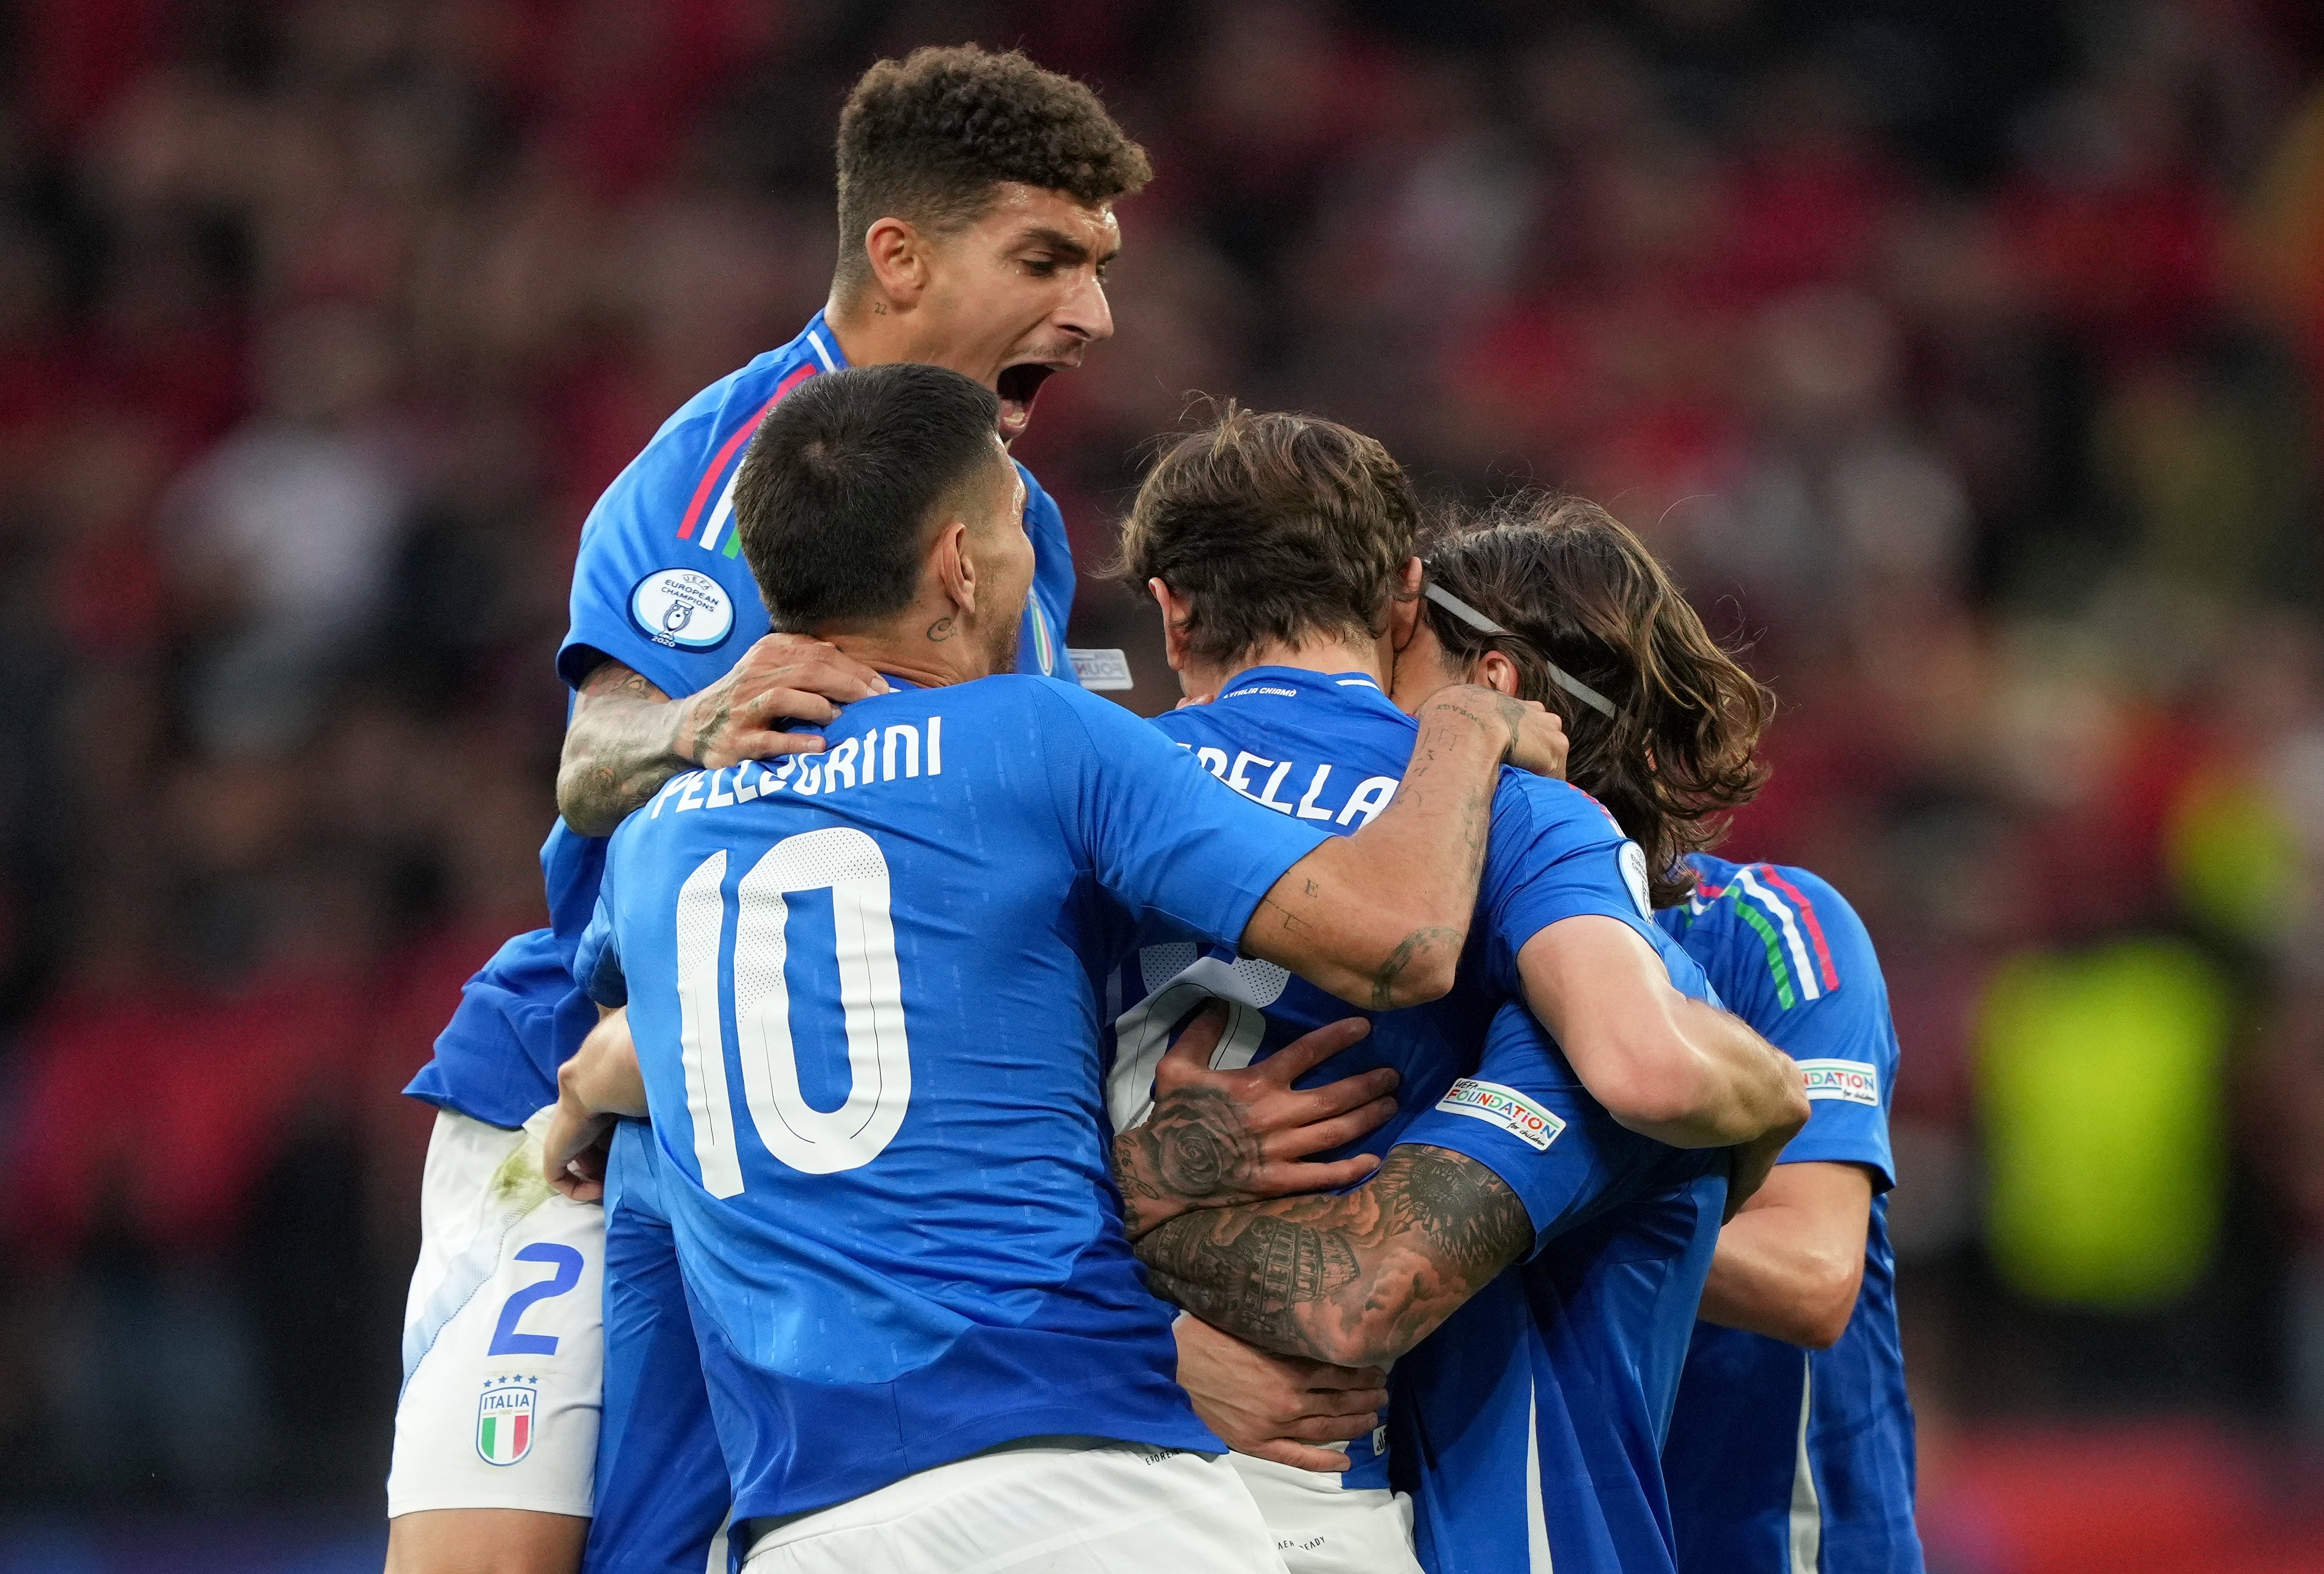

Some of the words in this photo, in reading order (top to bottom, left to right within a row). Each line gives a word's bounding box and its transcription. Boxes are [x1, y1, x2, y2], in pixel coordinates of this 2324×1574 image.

[682, 575, 713, 590] UEFA
[661, 587, 715, 612] CHAMPIONS
[665, 579, 719, 605] EUROPEAN
[651, 636, 676, 648] 2020
[1223, 687, 1258, 699] L'ITALIA
[1259, 687, 1297, 697] CHIAMÒ
[1176, 743, 1401, 831] RELLA
[676, 827, 912, 1200] 10
[1455, 1081, 1479, 1089] UEFA
[1520, 1130, 1546, 1147] children
[488, 1242, 584, 1356] 2
[483, 1394, 529, 1410] ITALIA
